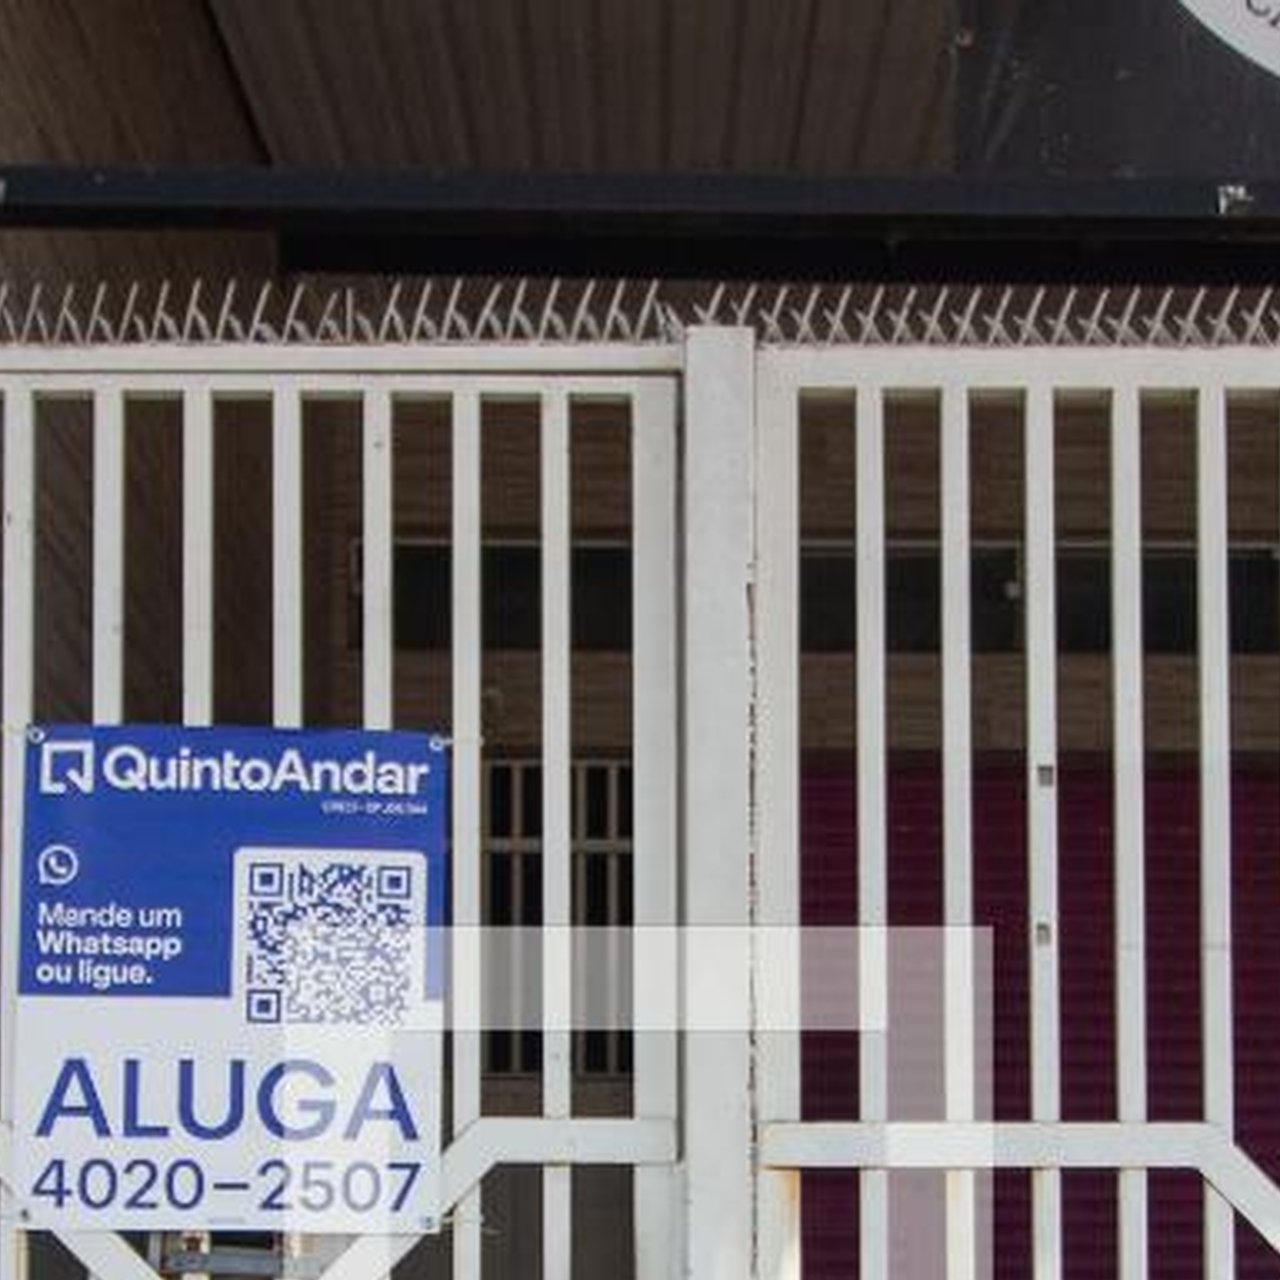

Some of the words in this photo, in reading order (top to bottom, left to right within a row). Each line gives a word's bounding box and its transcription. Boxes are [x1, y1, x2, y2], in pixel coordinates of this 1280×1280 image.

[102, 745, 430, 796] QuintoAndar
[138, 907, 183, 928] um
[36, 929, 183, 961] Whatsapp
[35, 963, 72, 984] ou
[78, 957, 154, 990] ligue.
[34, 1057, 421, 1142] ALUGA
[31, 1157, 423, 1214] 4020-2507
